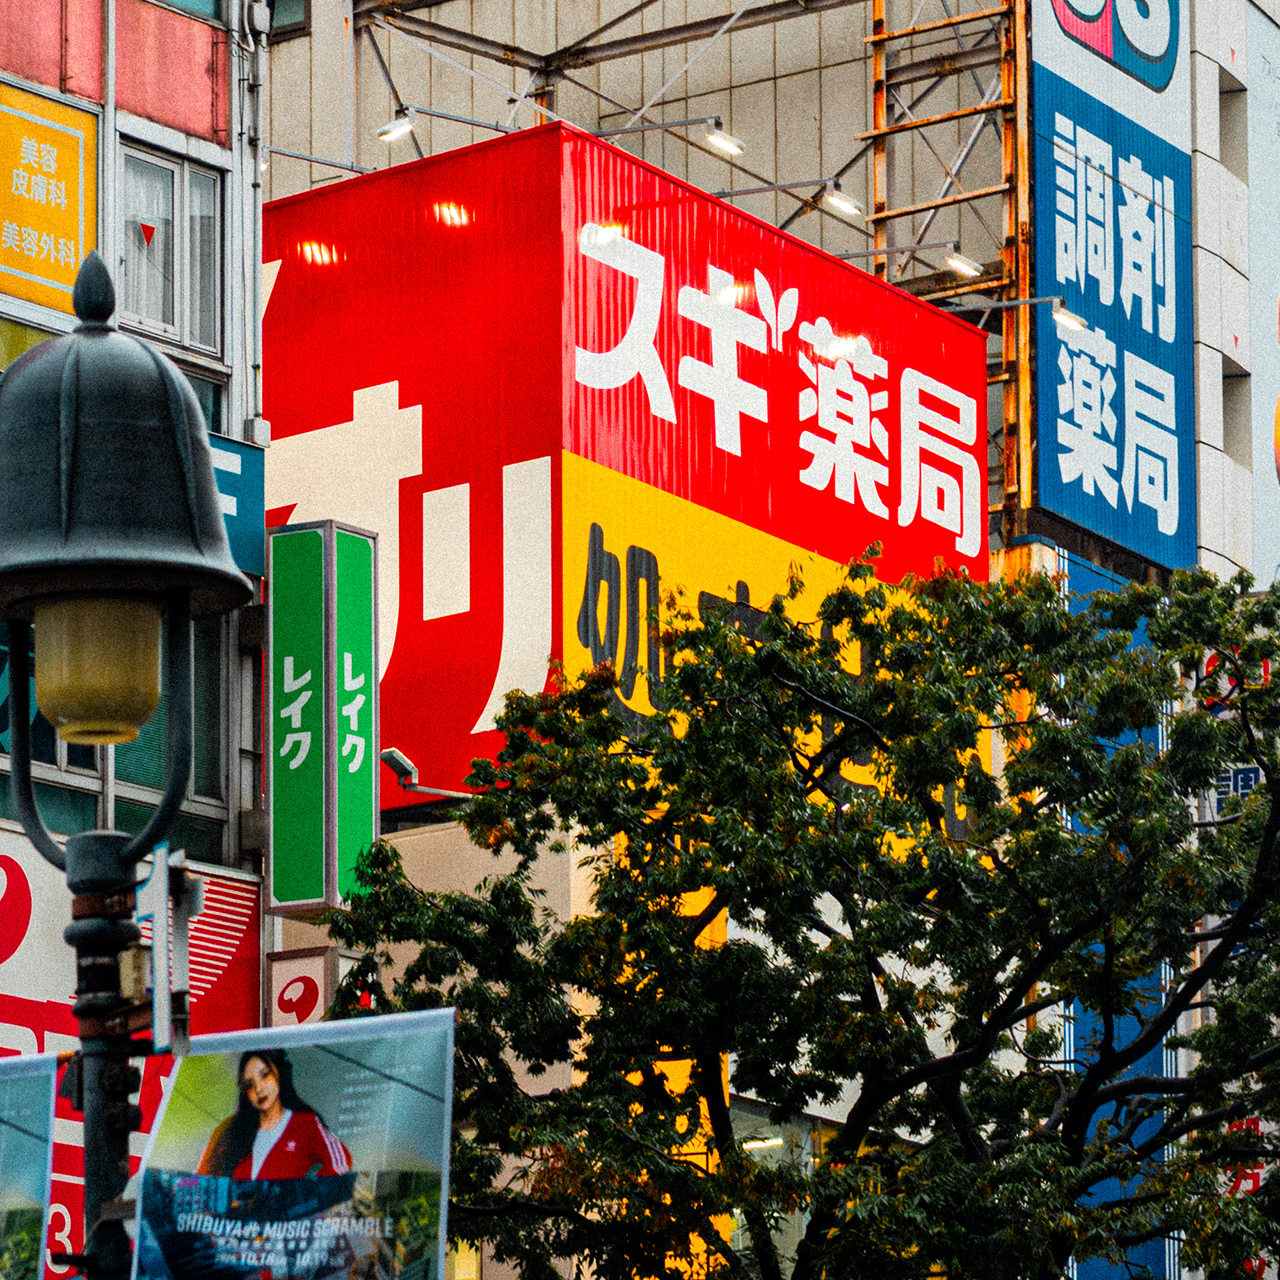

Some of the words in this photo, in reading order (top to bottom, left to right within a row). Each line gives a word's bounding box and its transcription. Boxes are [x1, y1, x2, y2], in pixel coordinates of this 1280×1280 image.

[10, 167, 67, 211] 皮膚科
[21, 135, 58, 174] 美容
[1, 219, 77, 270] 美容外科
[1053, 111, 1176, 345] 調剤
[575, 223, 981, 558] スギ薬局
[1055, 326, 1180, 537] 薬局
[280, 655, 313, 770] レイク
[341, 651, 366, 774] レイク
[176, 1212, 244, 1237] SHIBUYA
[263, 1220, 310, 1240] MUSIC
[312, 1218, 394, 1239] SCRAMBLE
